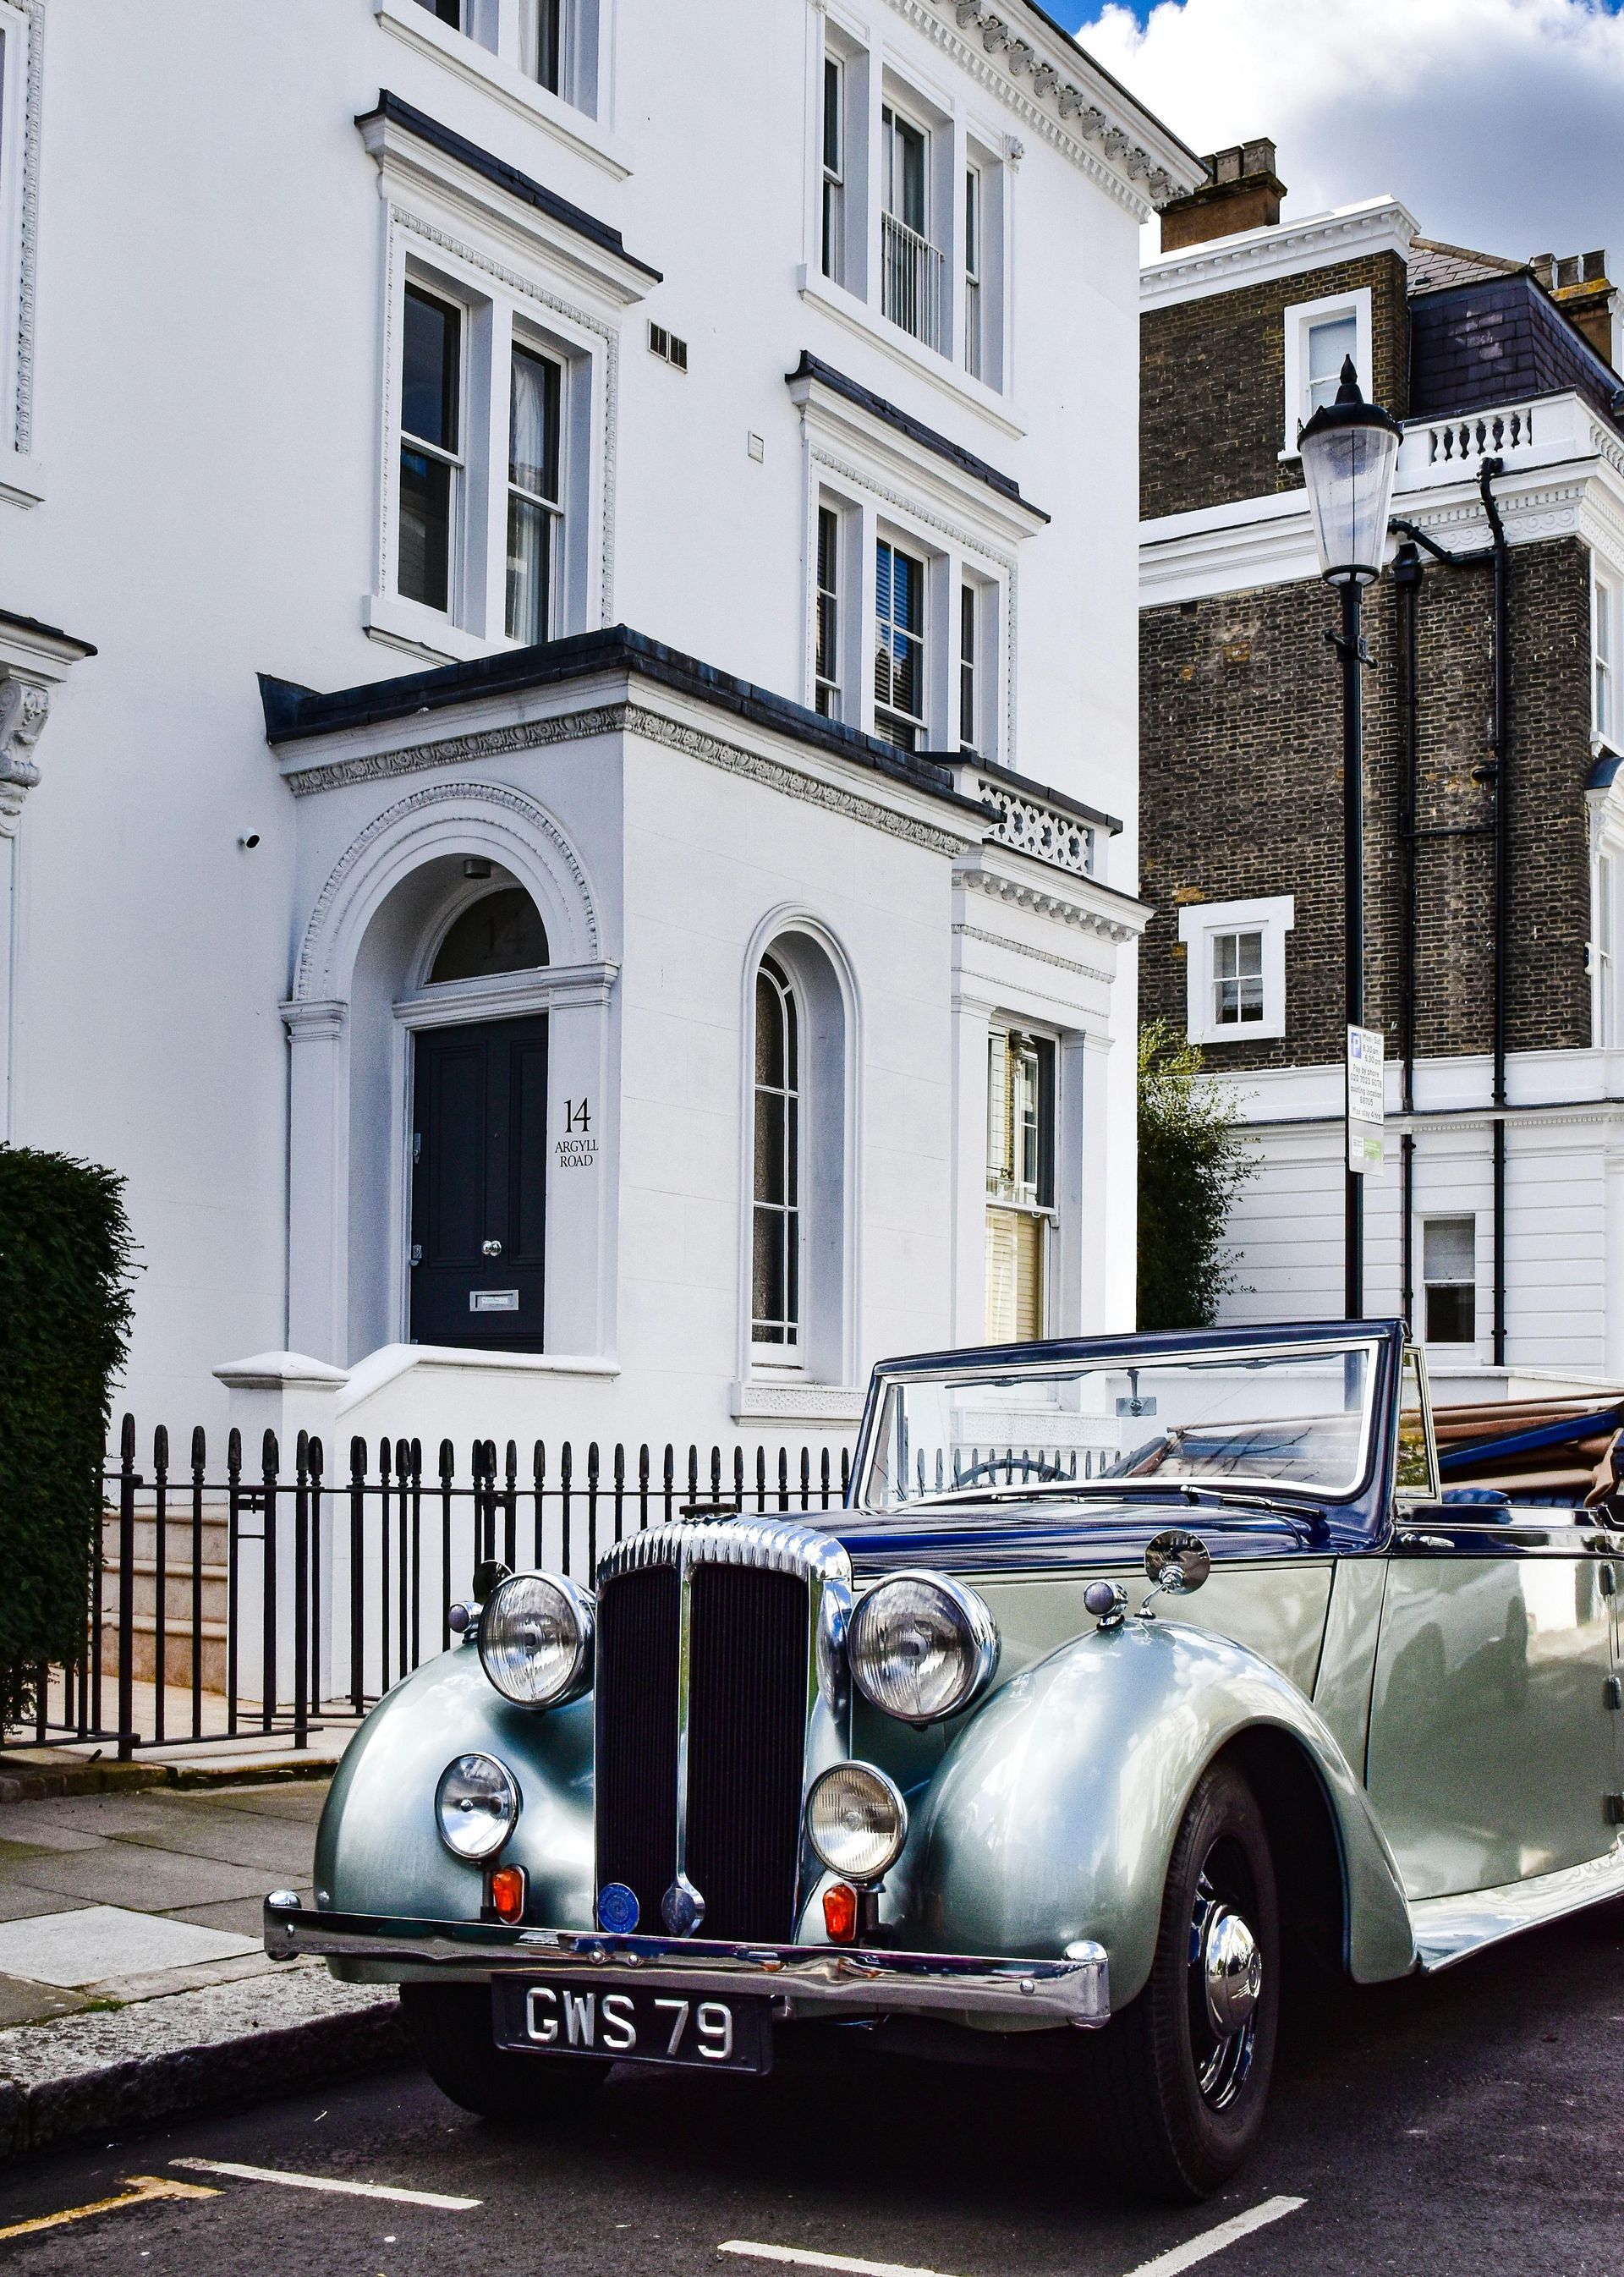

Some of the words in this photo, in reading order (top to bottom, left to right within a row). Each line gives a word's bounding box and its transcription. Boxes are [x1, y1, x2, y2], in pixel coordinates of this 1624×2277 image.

[1363, 1033, 1371, 1042] Mon
[1350, 1073, 1359, 1083] 020
[1361, 1066, 1366, 1076] by
[1367, 1067, 1380, 1078] phone
[1351, 1085, 1365, 1096] quoting
[1366, 1088, 1382, 1098] location
[563, 1097, 592, 1133] 14
[1352, 1106, 1361, 1116] Max
[1362, 1109, 1370, 1119] stay
[555, 1138, 599, 1154] ARGYLL
[560, 1155, 594, 1168] ROAD
[526, 1987, 637, 2049] GWS
[654, 1998, 733, 2061] 79
